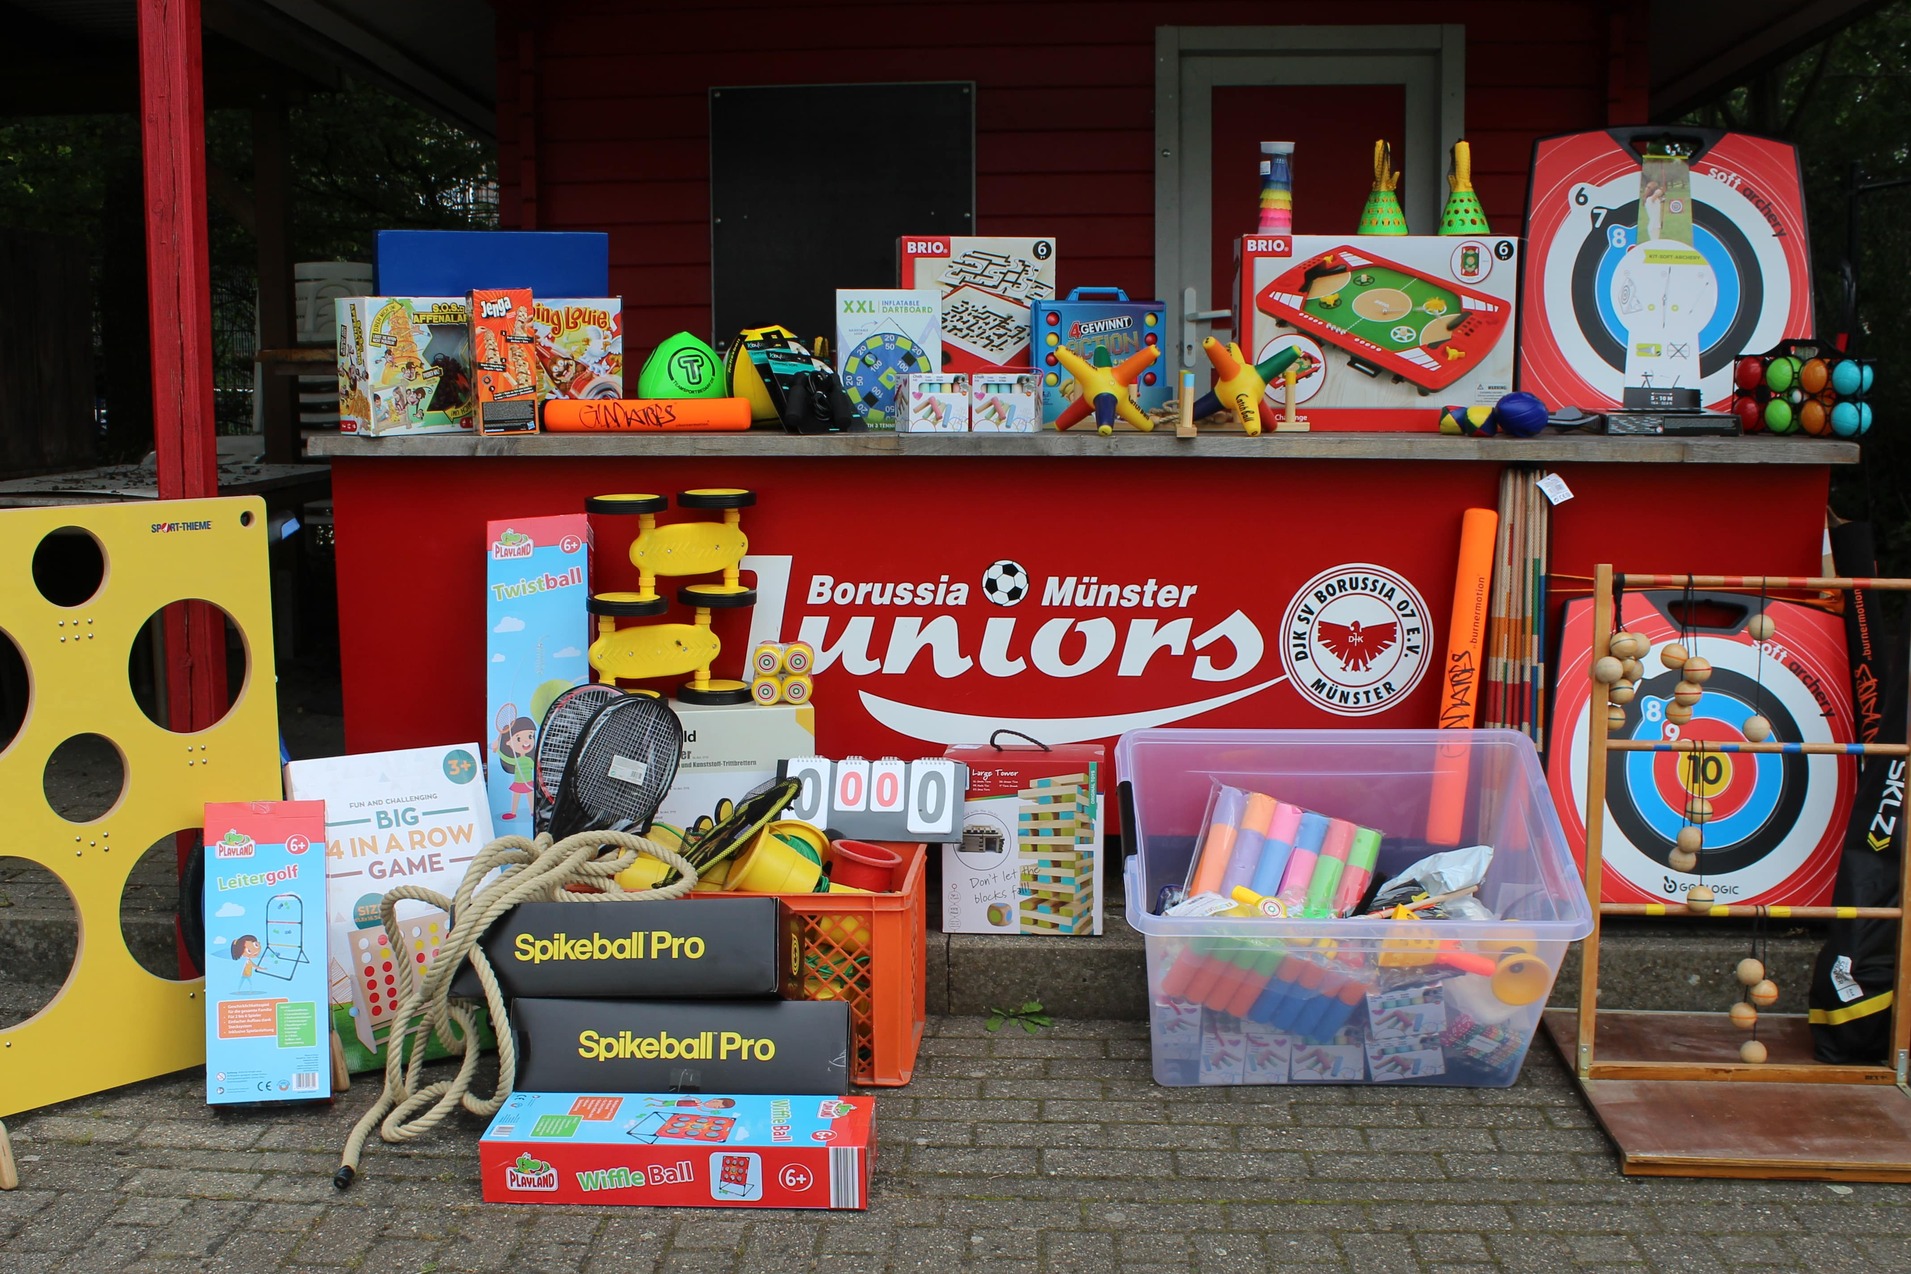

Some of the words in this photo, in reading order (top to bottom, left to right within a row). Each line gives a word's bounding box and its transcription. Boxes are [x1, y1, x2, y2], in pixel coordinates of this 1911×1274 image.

[1574, 187, 1589, 206] 6
[1708, 166, 1742, 192] soft
[1742, 186, 1788, 239] archery
[1593, 208, 1608, 229] 7
[907, 241, 945, 254] BRIO
[1037, 241, 1047, 255] 6
[1247, 239, 1286, 252] BRIO
[1498, 242, 1509, 255] 6
[1611, 229, 1627, 249] 8
[432, 302, 460, 313] S.O.S.
[481, 296, 512, 318] Jenga
[843, 300, 876, 314] XXL
[881, 306, 933, 314] DARTBOARD
[412, 313, 467, 324] AFFENALA
[565, 304, 610, 331] Louie
[1069, 321, 1082, 339] 4
[1080, 316, 1130, 334] GEWINNT
[856, 344, 867, 356] 20
[885, 343, 895, 351] 50
[911, 345, 923, 356] 20
[870, 360, 883, 373] 100
[897, 360, 909, 373] 100
[845, 375, 854, 386] 20
[856, 375, 864, 386] 50
[871, 386, 884, 398] 100
[856, 403, 869, 415] 20
[1235, 393, 1249, 413] Catch
[151, 520, 212, 533] SPORT-THIEME
[494, 543, 532, 558] PLAYLAND
[563, 538, 578, 551] 6+
[492, 566, 583, 601] Twistball
[806, 573, 970, 606] Borussia
[1040, 576, 1199, 609] Münster
[1313, 576, 1397, 604] BORUSSIA
[739, 555, 1265, 683] Juniors
[1297, 603, 1316, 625] SV
[1396, 599, 1418, 619] 07
[1469, 576, 1486, 645] burnermotion
[1853, 588, 1872, 658] burnermotion
[1292, 630, 1309, 662] DJK
[1404, 626, 1421, 658] E.V.
[1751, 639, 1788, 663] soft
[1788, 660, 1836, 717] archery
[1310, 677, 1397, 705] MÜNSTER
[1646, 700, 1662, 722] 8
[1665, 724, 1681, 741] 9
[447, 759, 472, 775] 3+
[972, 768, 993, 781] Large
[995, 768, 1019, 777] Tower
[1687, 755, 1723, 785] 10
[349, 801, 365, 809] FUN
[367, 798, 384, 807] AND
[386, 793, 438, 805] CHALLENGING
[794, 767, 822, 821] 0
[840, 771, 863, 807] 0
[876, 772, 899, 808] 0
[917, 770, 947, 824] 0
[1869, 760, 1906, 836] SKLZ
[375, 806, 420, 830] BIG
[218, 843, 254, 857] PLAYLAND
[289, 838, 306, 852] 6+
[326, 839, 344, 860] 4
[349, 834, 379, 858] IN
[384, 832, 405, 854] A
[408, 823, 474, 851] ROW
[368, 852, 444, 880] GAME
[217, 864, 299, 891] Leitergolf
[969, 873, 998, 889] Don't
[1002, 869, 1018, 882] let
[1021, 866, 1041, 876] the
[974, 889, 1008, 904] blocks
[514, 932, 645, 964] Spikeball
[651, 931, 706, 960] Pro
[578, 1030, 713, 1062] Spikeball
[719, 1031, 776, 1061] Pro
[772, 1099, 791, 1124] Wiffle
[772, 1125, 792, 1142] Ball
[510, 1170, 555, 1188] PLAYLAND
[578, 1167, 645, 1191] Wiffle
[649, 1161, 694, 1185] Ball
[785, 1169, 807, 1186] 6+
